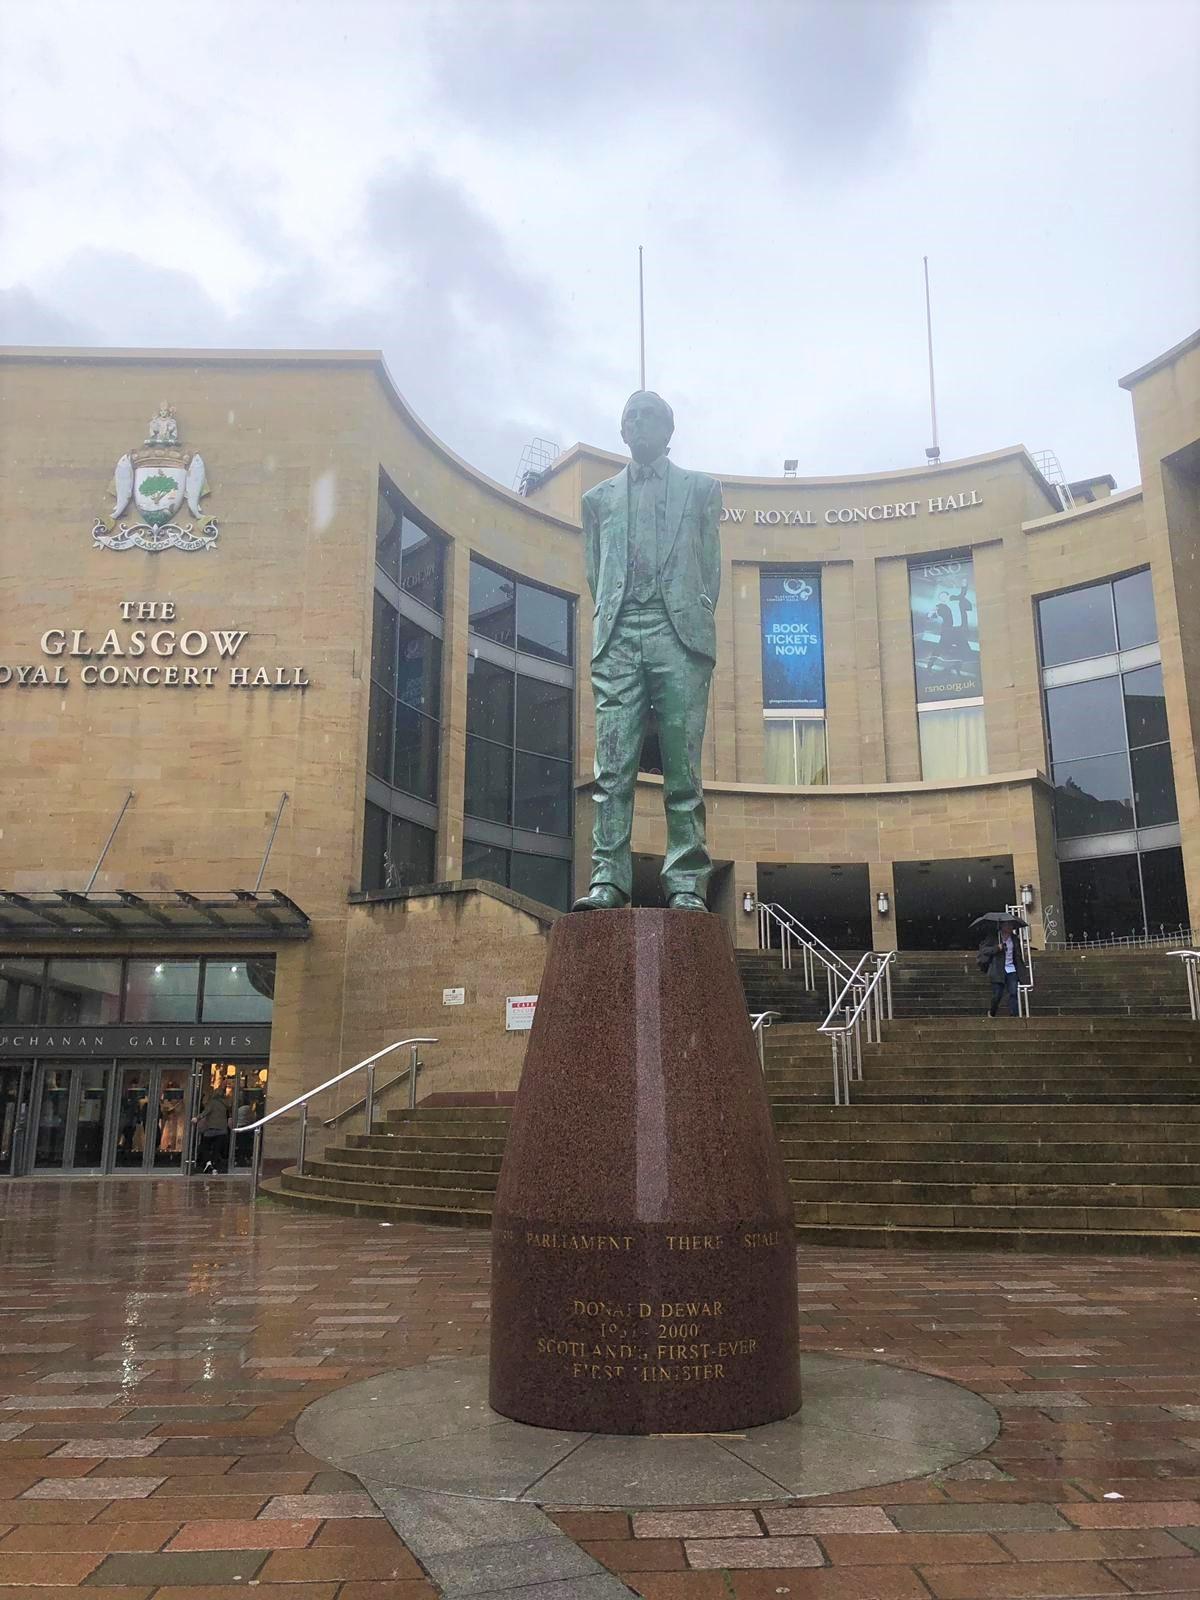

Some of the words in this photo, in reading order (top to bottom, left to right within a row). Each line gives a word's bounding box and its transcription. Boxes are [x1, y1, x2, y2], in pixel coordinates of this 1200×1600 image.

[754, 510, 817, 525] ROYAL
[824, 501, 920, 524] CONCERT
[928, 490, 983, 513] HALL
[119, 601, 176, 620] THE
[772, 623, 808, 634] BOOK
[40, 628, 249, 656] GLASGOW
[765, 634, 818, 646] TICKETS
[775, 645, 807, 656] NOW
[0, 665, 70, 685] OYAL
[80, 665, 219, 685] CONCERT
[228, 666, 309, 686] HALL
[924, 680, 976, 693] rsno.org.uk
[129, 1036, 252, 1047] GALLERIES
[526, 1231, 633, 1251] PARLIAMENT
[666, 1235, 724, 1250] THERE
[744, 1231, 780, 1249] SHALL
[661, 1301, 723, 1318] DEWAR
[658, 1323, 699, 1339] 2000
[657, 1339, 757, 1361] FIRST-EVER
